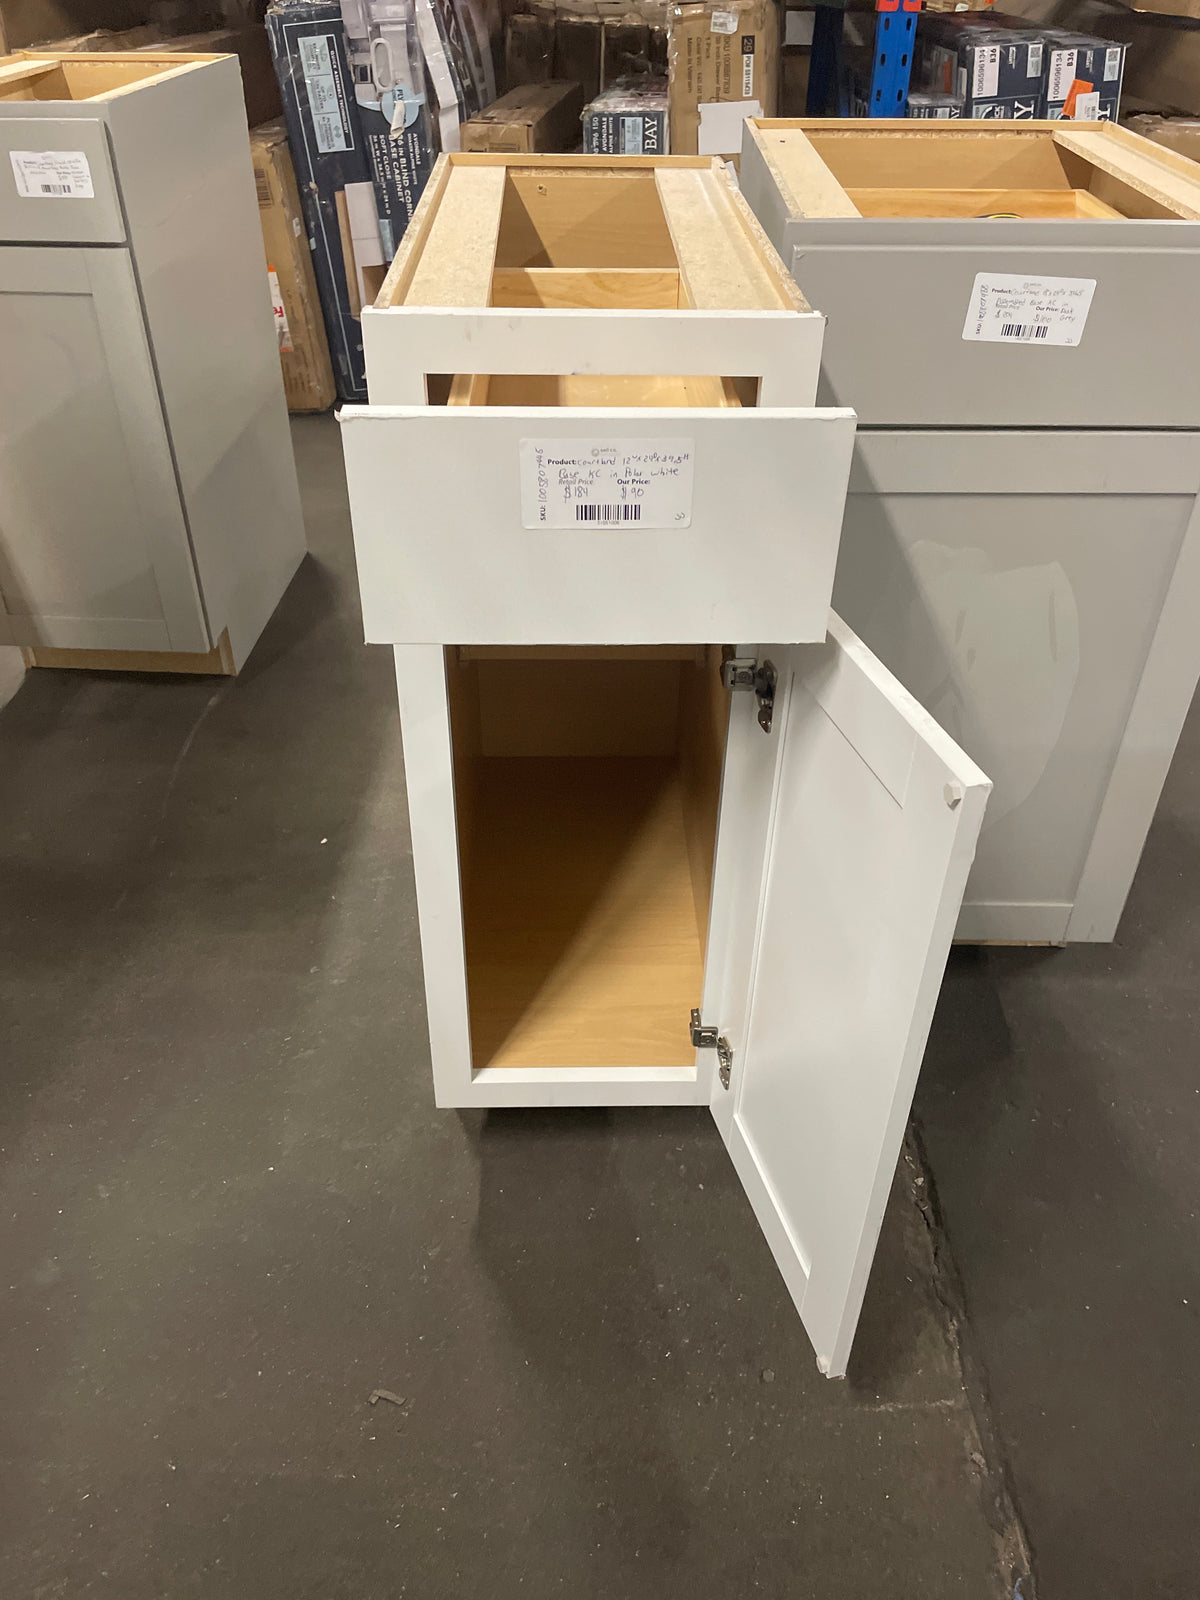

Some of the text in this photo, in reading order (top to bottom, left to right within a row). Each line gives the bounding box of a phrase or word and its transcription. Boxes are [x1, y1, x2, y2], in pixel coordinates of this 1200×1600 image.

[743, 38, 753, 52] 29
[989, 48, 997, 64] B36
[1067, 51, 1075, 67] B36
[1053, 53, 1062, 99] 1006596134
[339, 99, 349, 134] TECHNOLOGY
[644, 117, 658, 150] BAY
[379, 134, 392, 180] SOFT CLOSE
[398, 147, 404, 156] IN
[412, 133, 421, 165] AVONDALE
[392, 161, 405, 203] CABINET
[399, 157, 410, 187] BLIND
[404, 189, 414, 222] CORN
[547, 458, 577, 466] Product:
[558, 478, 577, 486] Retail
[616, 478, 651, 486] Our Price:
[539, 504, 547, 521] SKU:
